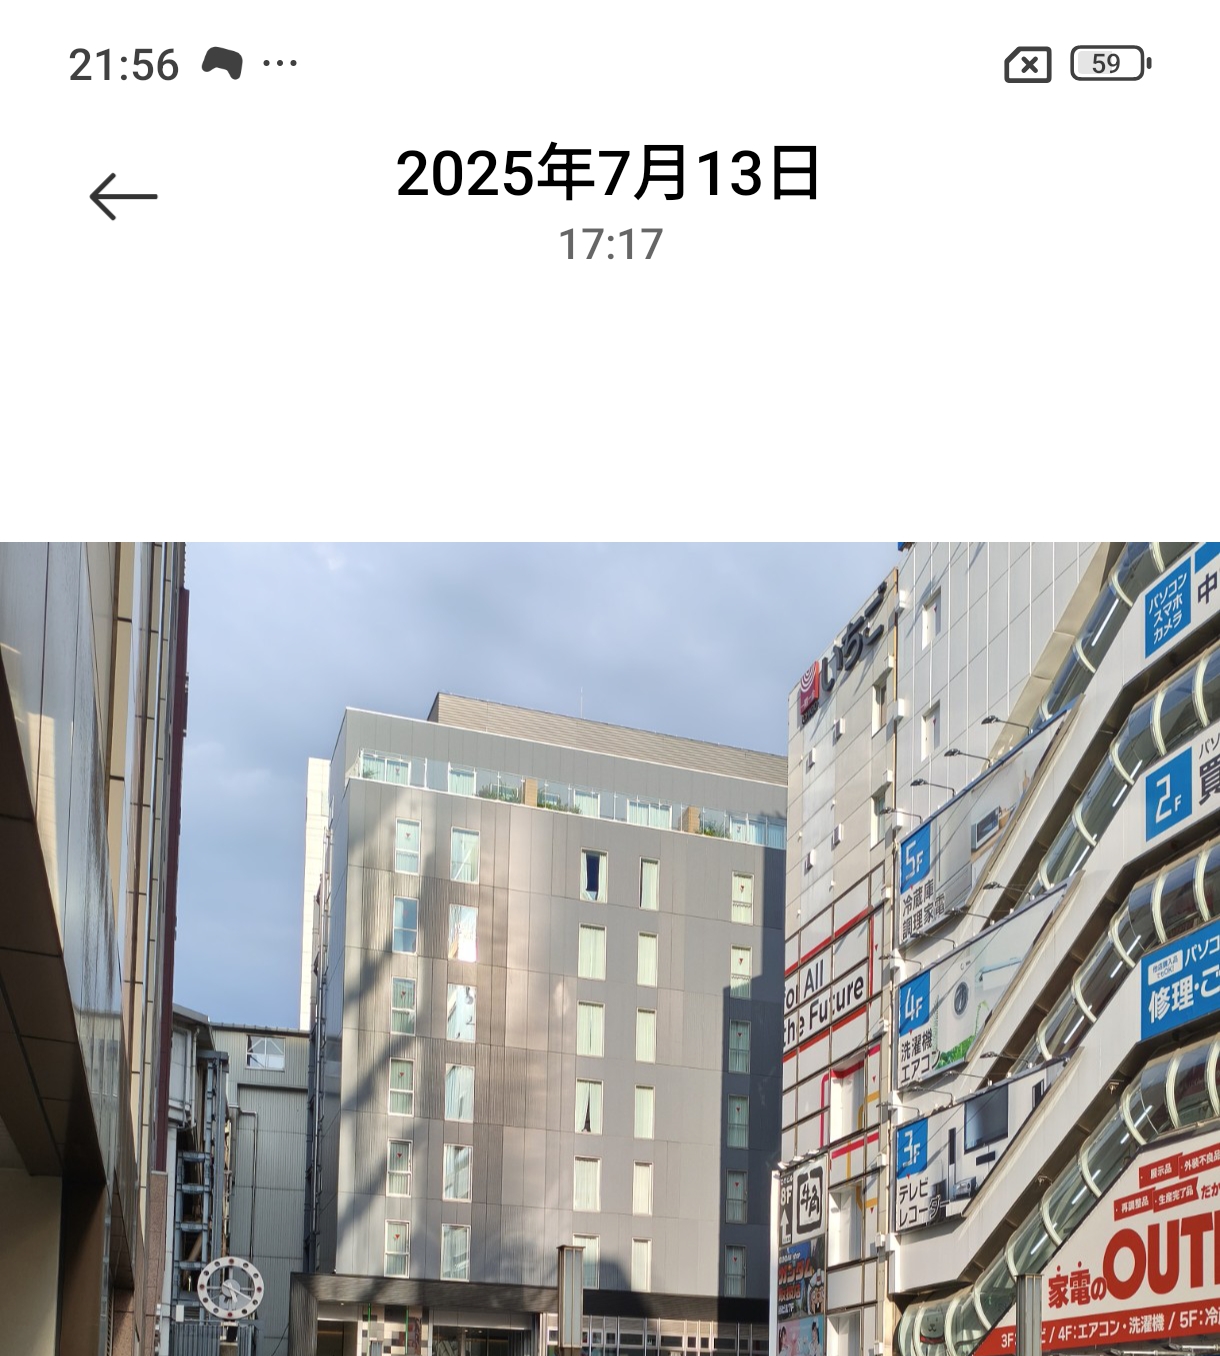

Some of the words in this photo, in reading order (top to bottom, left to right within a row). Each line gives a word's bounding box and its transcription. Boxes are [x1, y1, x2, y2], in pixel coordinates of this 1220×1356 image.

[1149, 572, 1187, 615] パソコン
[1153, 593, 1183, 628] スマホ
[1153, 610, 1182, 645] カメラ
[1156, 773, 1182, 824] 2F
[905, 840, 924, 881] 5F
[902, 878, 934, 917] 冷蔵庫
[902, 892, 945, 941] 調理家電
[803, 958, 824, 998] All
[905, 986, 923, 1021] 4F
[901, 1028, 933, 1062] 洗濯機
[901, 1048, 941, 1084] エアコン
[903, 1129, 921, 1168] 3F
[1150, 1162, 1172, 1180] 展示品
[781, 1185, 792, 1207] 8F
[899, 1176, 929, 1205] テレビ
[1121, 1195, 1149, 1214] 再調整品
[1158, 1184, 1194, 1206] 生産完了品
[900, 1195, 951, 1227] レコーダー
